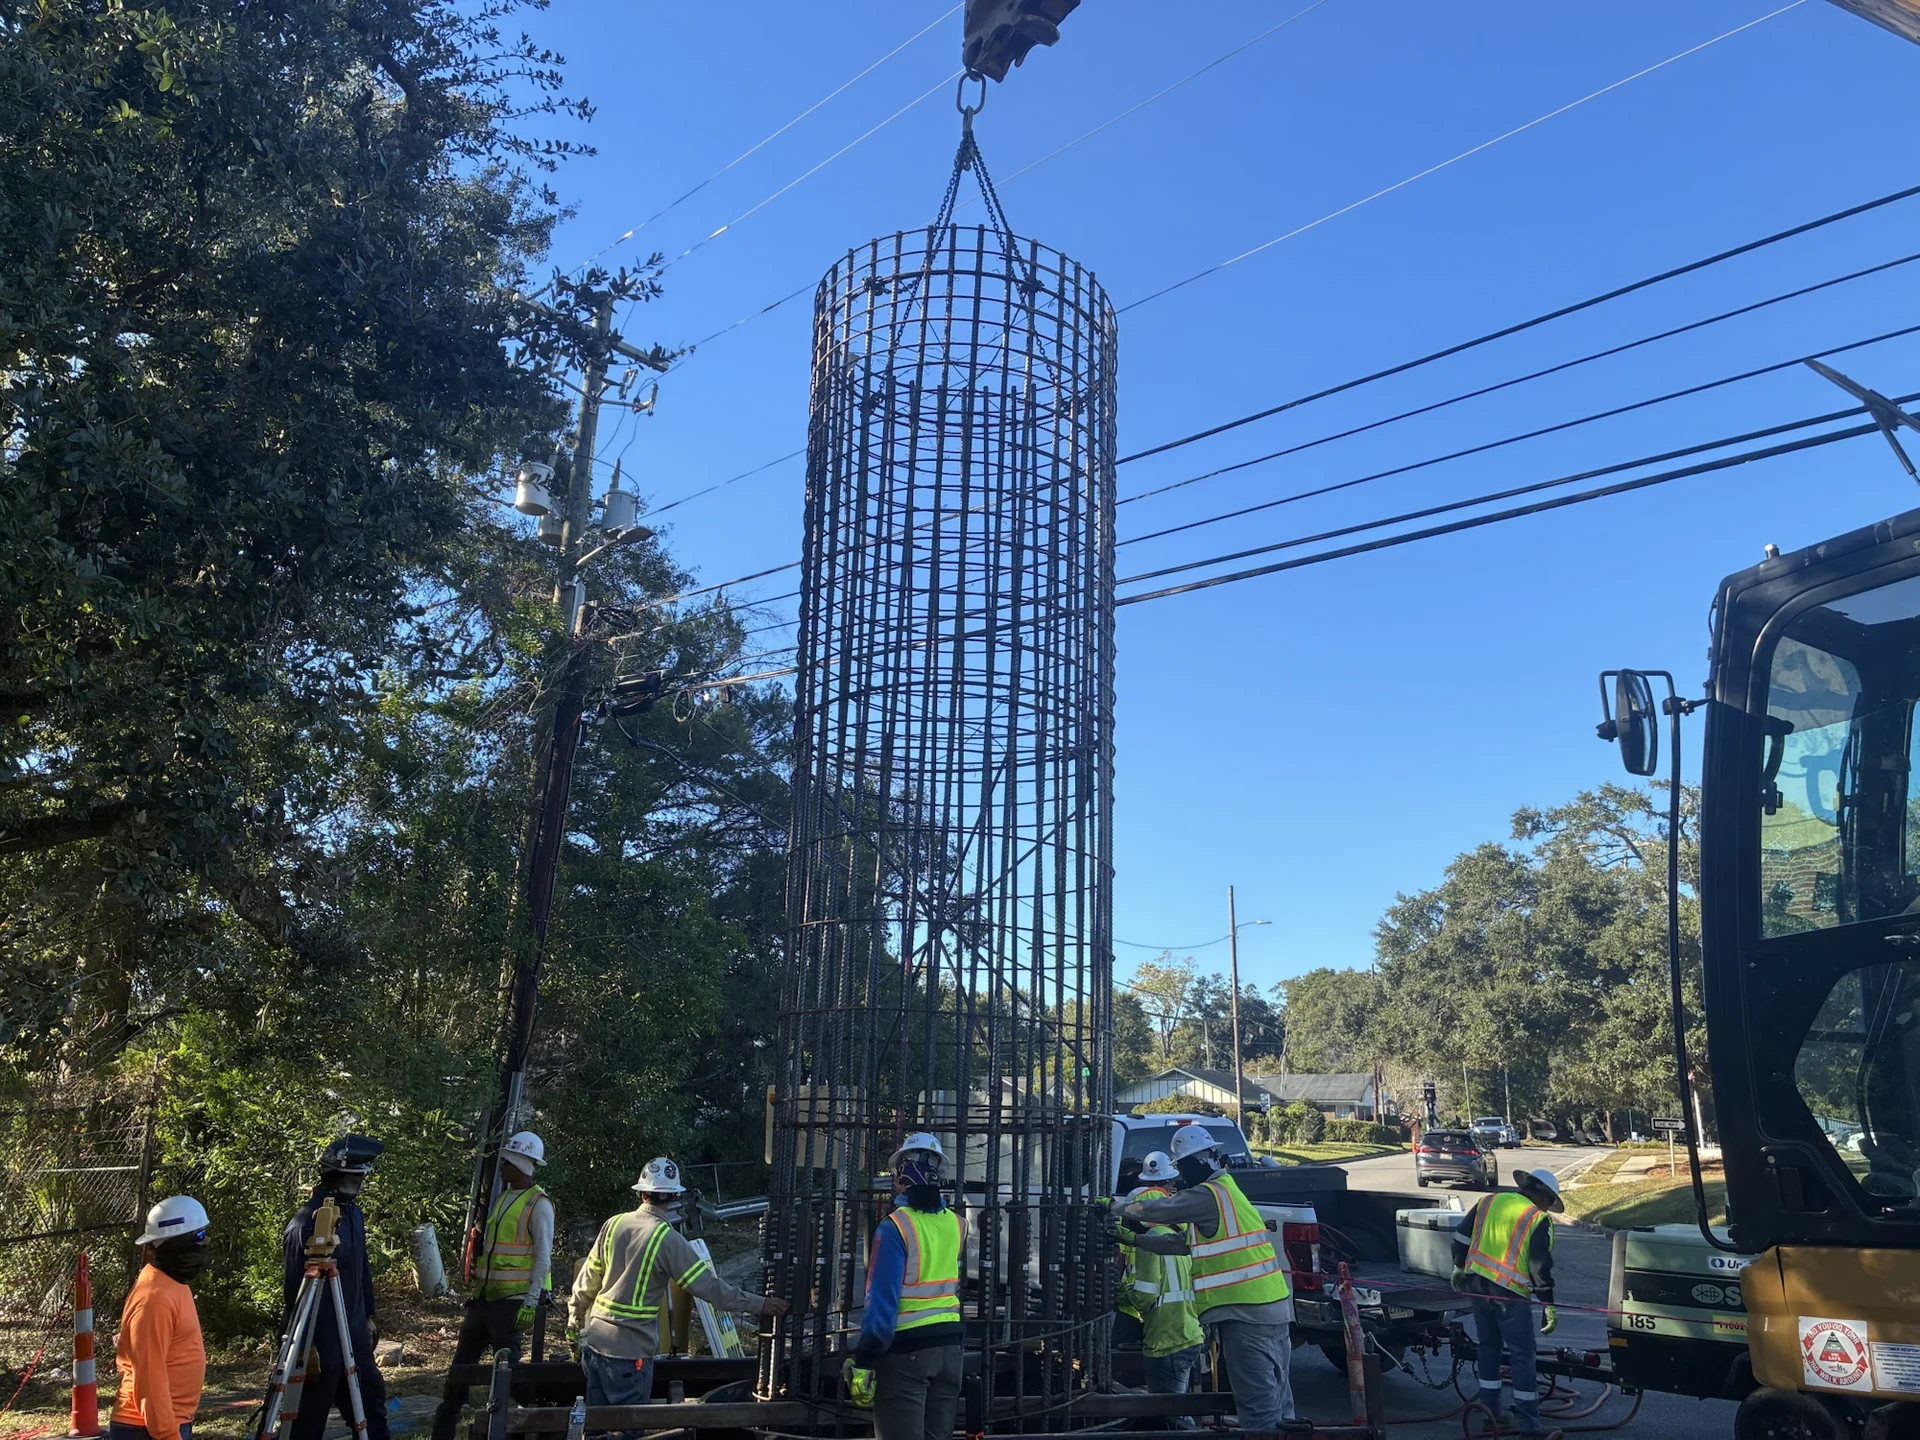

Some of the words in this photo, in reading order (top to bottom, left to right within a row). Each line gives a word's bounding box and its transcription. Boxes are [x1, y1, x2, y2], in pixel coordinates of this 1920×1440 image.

[1627, 1313, 1656, 1330] 185
[1817, 1322, 1832, 1331] YOU
[1844, 1327, 1859, 1345] YOUR
[1819, 1371, 1838, 1385] WALK
